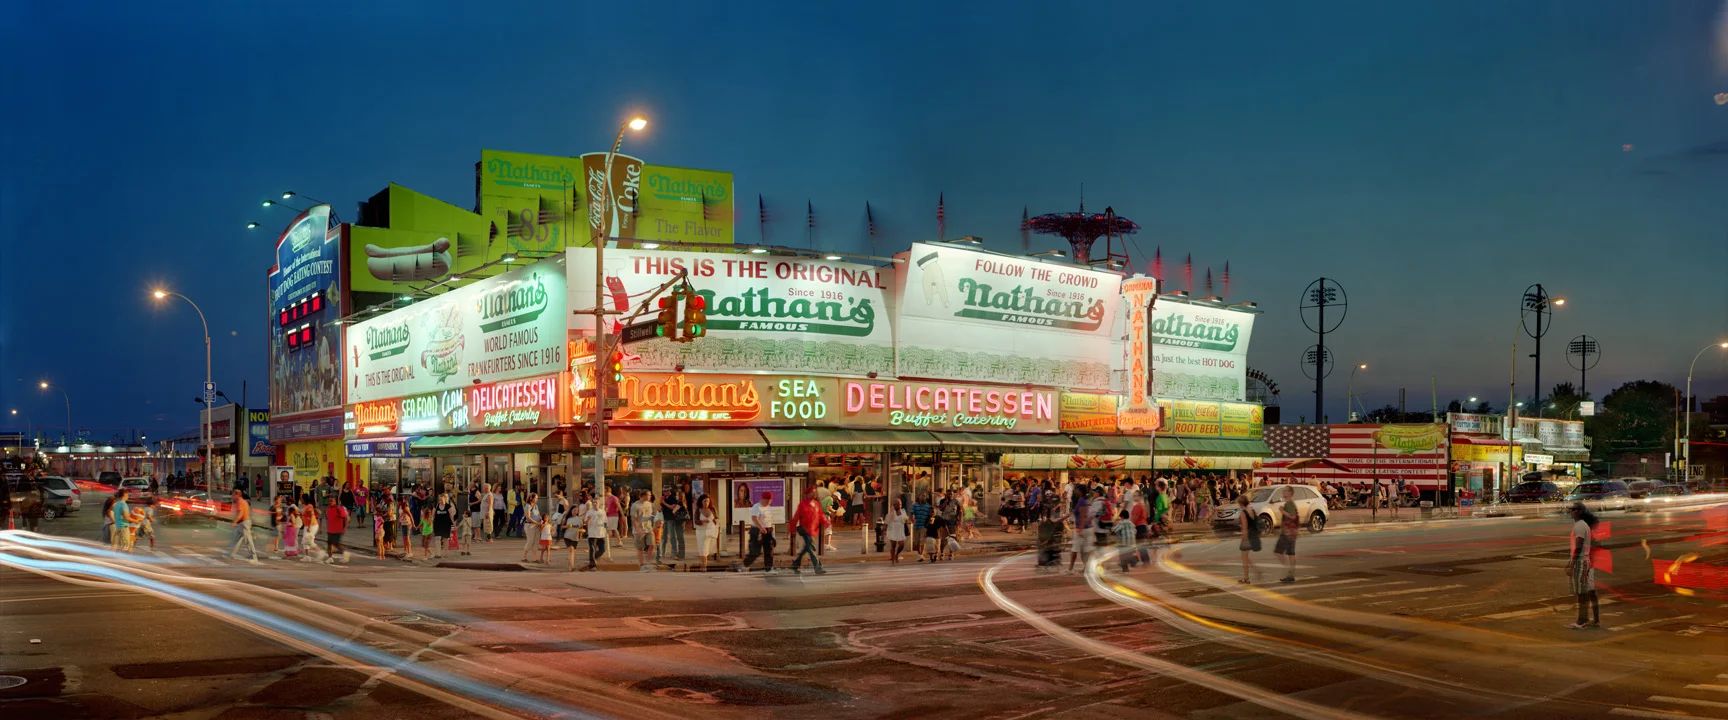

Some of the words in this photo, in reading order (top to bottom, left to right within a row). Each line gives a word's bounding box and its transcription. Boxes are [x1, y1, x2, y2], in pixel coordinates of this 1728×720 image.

[488, 157, 575, 184] Nathan's
[617, 164, 641, 213] Coke
[648, 173, 726, 198] Nathan's
[655, 218, 679, 234] The
[684, 220, 724, 237] Flavor
[310, 260, 333, 276] CONTEST
[629, 256, 684, 276] THIS
[693, 258, 715, 277] IS
[722, 260, 768, 279] THE
[775, 261, 887, 290] ORIGINAL
[975, 259, 1025, 278] FOLLOW
[1031, 267, 1053, 282] THE
[1058, 272, 1098, 289] CROWD
[477, 272, 546, 320] Nathan's
[788, 287, 815, 297] Since
[821, 290, 844, 301] 1916
[958, 277, 1105, 320] Nathan's
[1046, 288, 1066, 299] Since
[1069, 291, 1085, 301] 1916
[739, 321, 809, 331] FAMOUS
[1001, 314, 1053, 327] FAMOUS
[1152, 312, 1238, 342] athan's
[1194, 315, 1210, 325] Since
[1212, 317, 1225, 326] 1916
[366, 321, 410, 350] Nathan's
[484, 333, 507, 353] WORLD
[509, 327, 538, 349] FAMOUS
[630, 326, 653, 339] Stillwell
[1160, 338, 1200, 348] FAMOUS
[468, 357, 516, 377] FRANKFURTERS
[518, 350, 538, 370] SINCE
[541, 346, 561, 364] 1916
[1161, 354, 1173, 364] just
[1175, 355, 1187, 364] the
[1187, 356, 1201, 365] best
[1202, 358, 1217, 367] HOT
[1219, 359, 1235, 368] DOG
[365, 372, 376, 387] THIS
[377, 371, 381, 386] IS
[382, 369, 391, 384] THE
[392, 365, 415, 382] ORIGINAL
[473, 378, 555, 416] DELICATESSEN
[619, 374, 759, 407] Nathan's
[778, 380, 819, 397] SEA
[402, 398, 415, 420] SEA
[417, 395, 437, 418] FOOD
[442, 388, 462, 417] CLAM
[771, 401, 826, 419] FOOD
[847, 382, 1052, 419] DELICATESSEN
[355, 402, 397, 424] Nathan's
[452, 405, 468, 429] BAR
[484, 412, 508, 426] Buffet
[508, 408, 540, 424] Catering
[643, 410, 709, 419] FAMOUS
[890, 410, 947, 427] Buffet
[953, 412, 1017, 429] Catering
[1175, 408, 1194, 418] FRIES
[1195, 404, 1218, 417] Coca-Cola
[1061, 416, 1116, 430] FRANKFURTERS
[1175, 423, 1198, 433] ROOT
[1200, 423, 1219, 434] BEER
[1389, 435, 1434, 449] Nathan's
